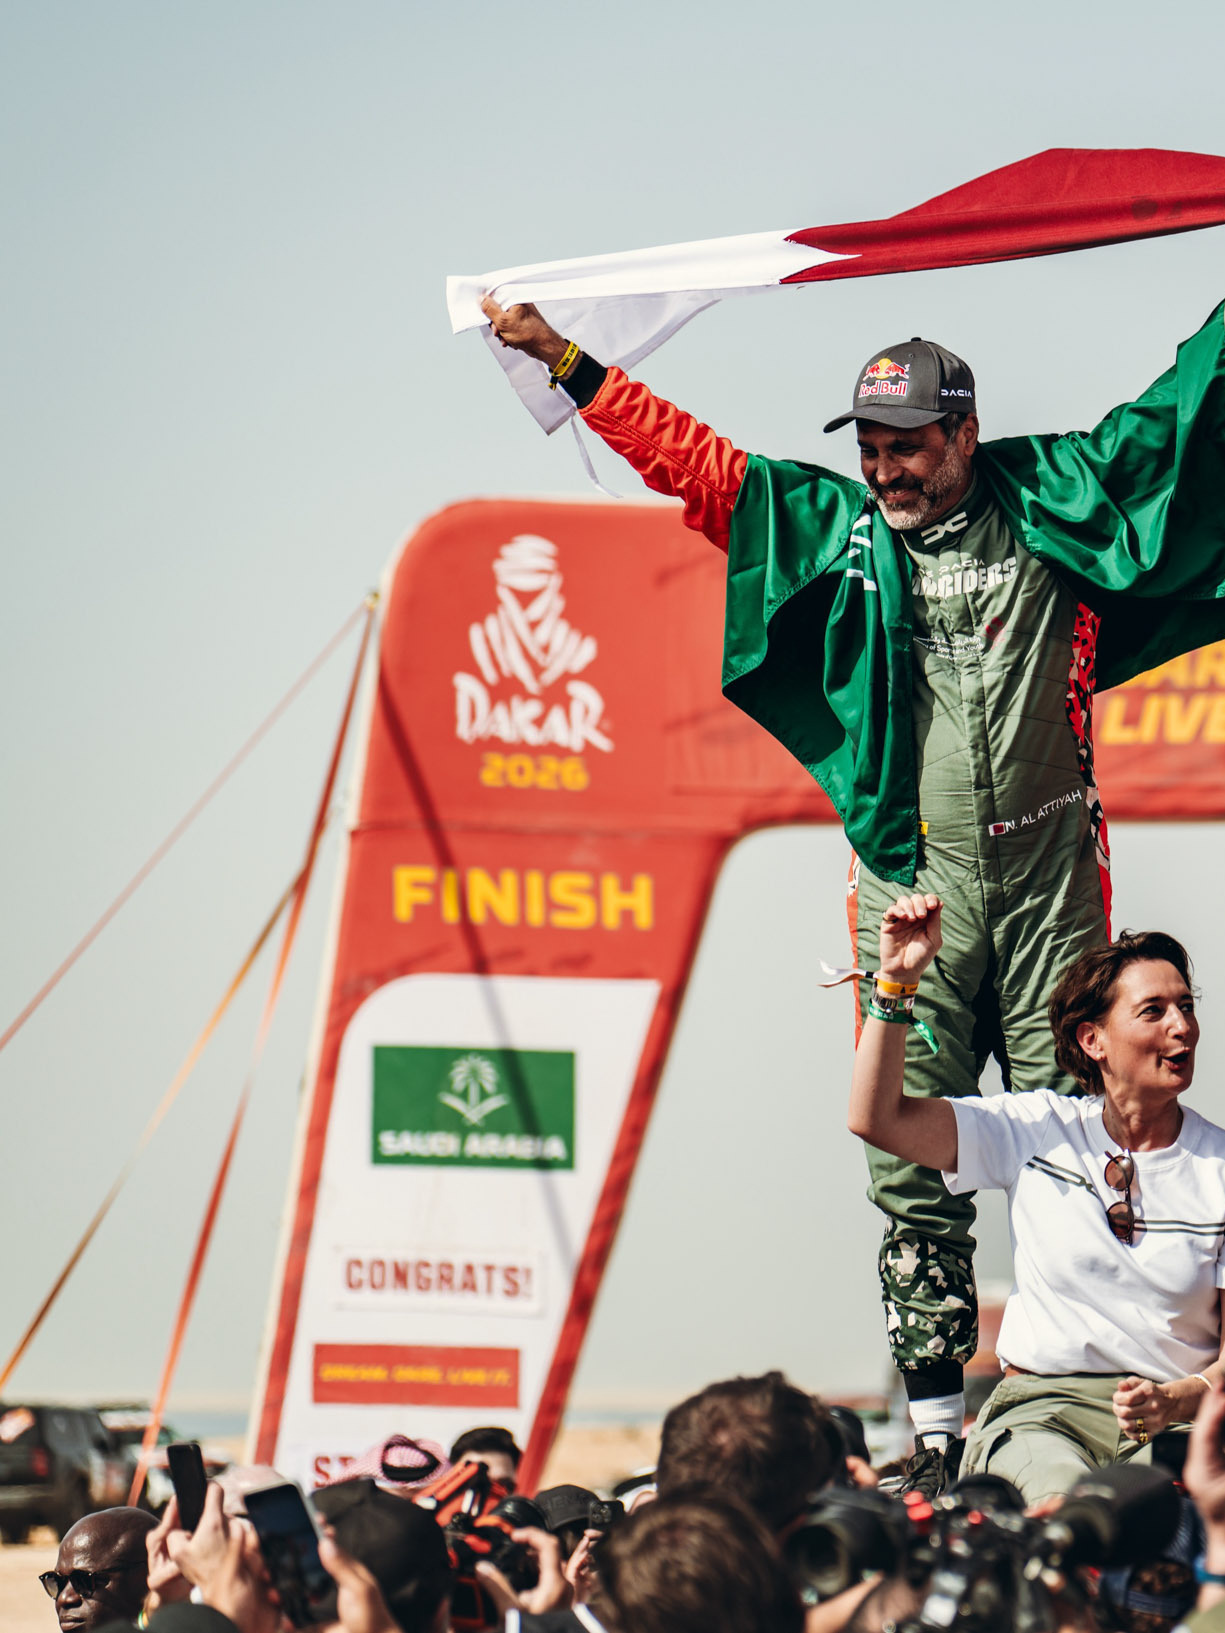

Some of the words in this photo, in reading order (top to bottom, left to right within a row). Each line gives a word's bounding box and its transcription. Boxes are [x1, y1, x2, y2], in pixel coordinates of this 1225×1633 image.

[858, 381, 880, 399] Red
[879, 380, 909, 397] Bull
[940, 388, 973, 398] DACIA
[453, 670, 614, 752] DAKAR
[479, 752, 590, 791] 2026
[1020, 812, 1037, 828] AL
[1037, 789, 1083, 820] ATTIYAH
[392, 864, 655, 931] FINISH
[378, 1129, 461, 1158] SAUDI
[463, 1132, 568, 1161] ARABIA
[345, 1259, 533, 1298] CONGRATS!
